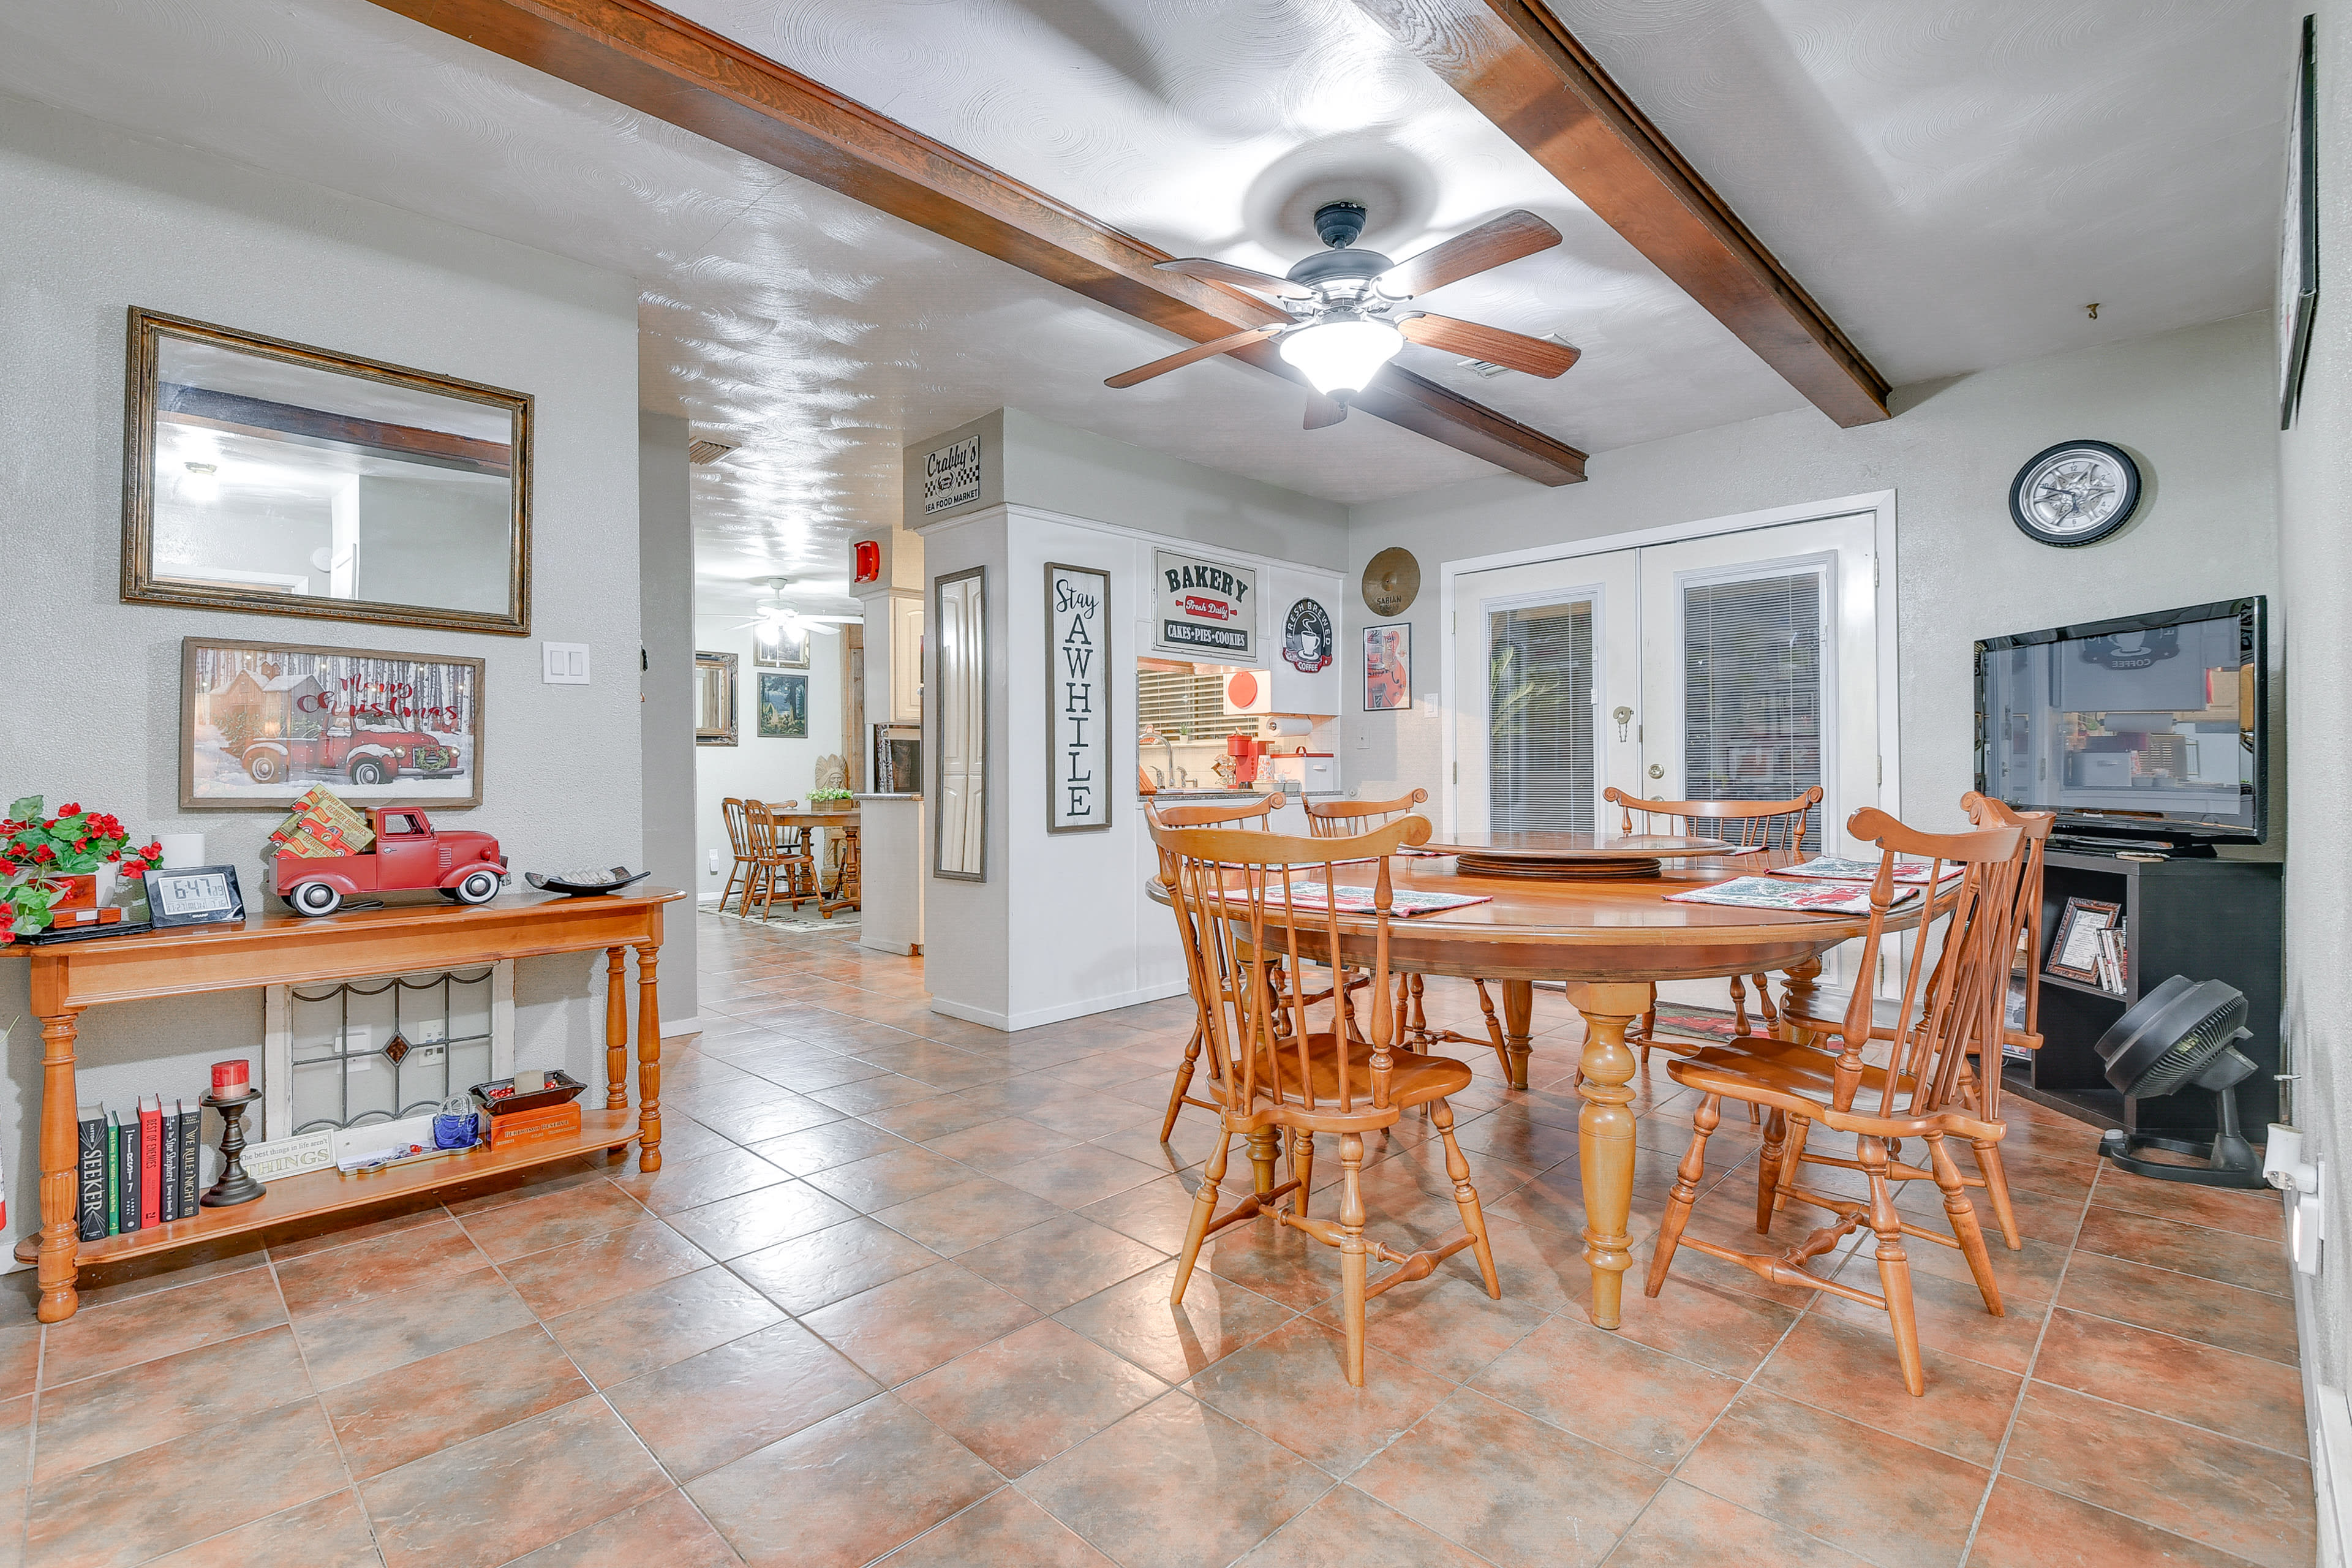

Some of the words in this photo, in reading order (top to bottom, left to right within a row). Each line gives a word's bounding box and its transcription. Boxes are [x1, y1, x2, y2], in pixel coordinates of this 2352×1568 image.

[927, 440, 977, 478] Crabby's
[936, 497, 952, 510] FOOD
[954, 488, 978, 503] MARKET
[1164, 565, 1249, 603] BAKERY
[1055, 578, 1099, 619] Stay
[1185, 599, 1207, 612] Fresh
[1208, 602, 1228, 619] Daily
[1376, 595, 1402, 605] SABIAN
[1287, 602, 1304, 639] FRESH
[1307, 601, 1331, 646] BREWED
[1167, 624, 1191, 640] CAKES
[1194, 627, 1212, 643] PIES
[1215, 630, 1245, 647] COOKIES
[1298, 662, 1319, 671] COFFEE
[339, 673, 417, 698] Merry
[296, 690, 460, 720] Christmas
[318, 790, 339, 805] BEAVER
[325, 804, 347, 821] BEAVER
[344, 818, 369, 837] BUDDIES
[302, 835, 323, 850] BEAVER
[173, 878, 212, 899] 6:47
[146, 1118, 157, 1134] BEST
[185, 1126, 198, 1146] WE
[504, 1126, 540, 1139] PERDOMO
[540, 1120, 570, 1130] RESERVE
[146, 1134, 157, 1143] OF
[165, 1138, 176, 1152] Star
[254, 1150, 268, 1159] best
[270, 1146, 290, 1155] things
[310, 1138, 328, 1147] aren't
[146, 1144, 157, 1169] ENEMIES
[164, 1152, 176, 1183] Shepherd
[182, 1147, 195, 1170] RULE
[244, 1148, 330, 1177] THINGS
[83, 1149, 103, 1216] SEEKER
[127, 1182, 134, 1193] 7
[184, 1173, 196, 1203] NIGHT
